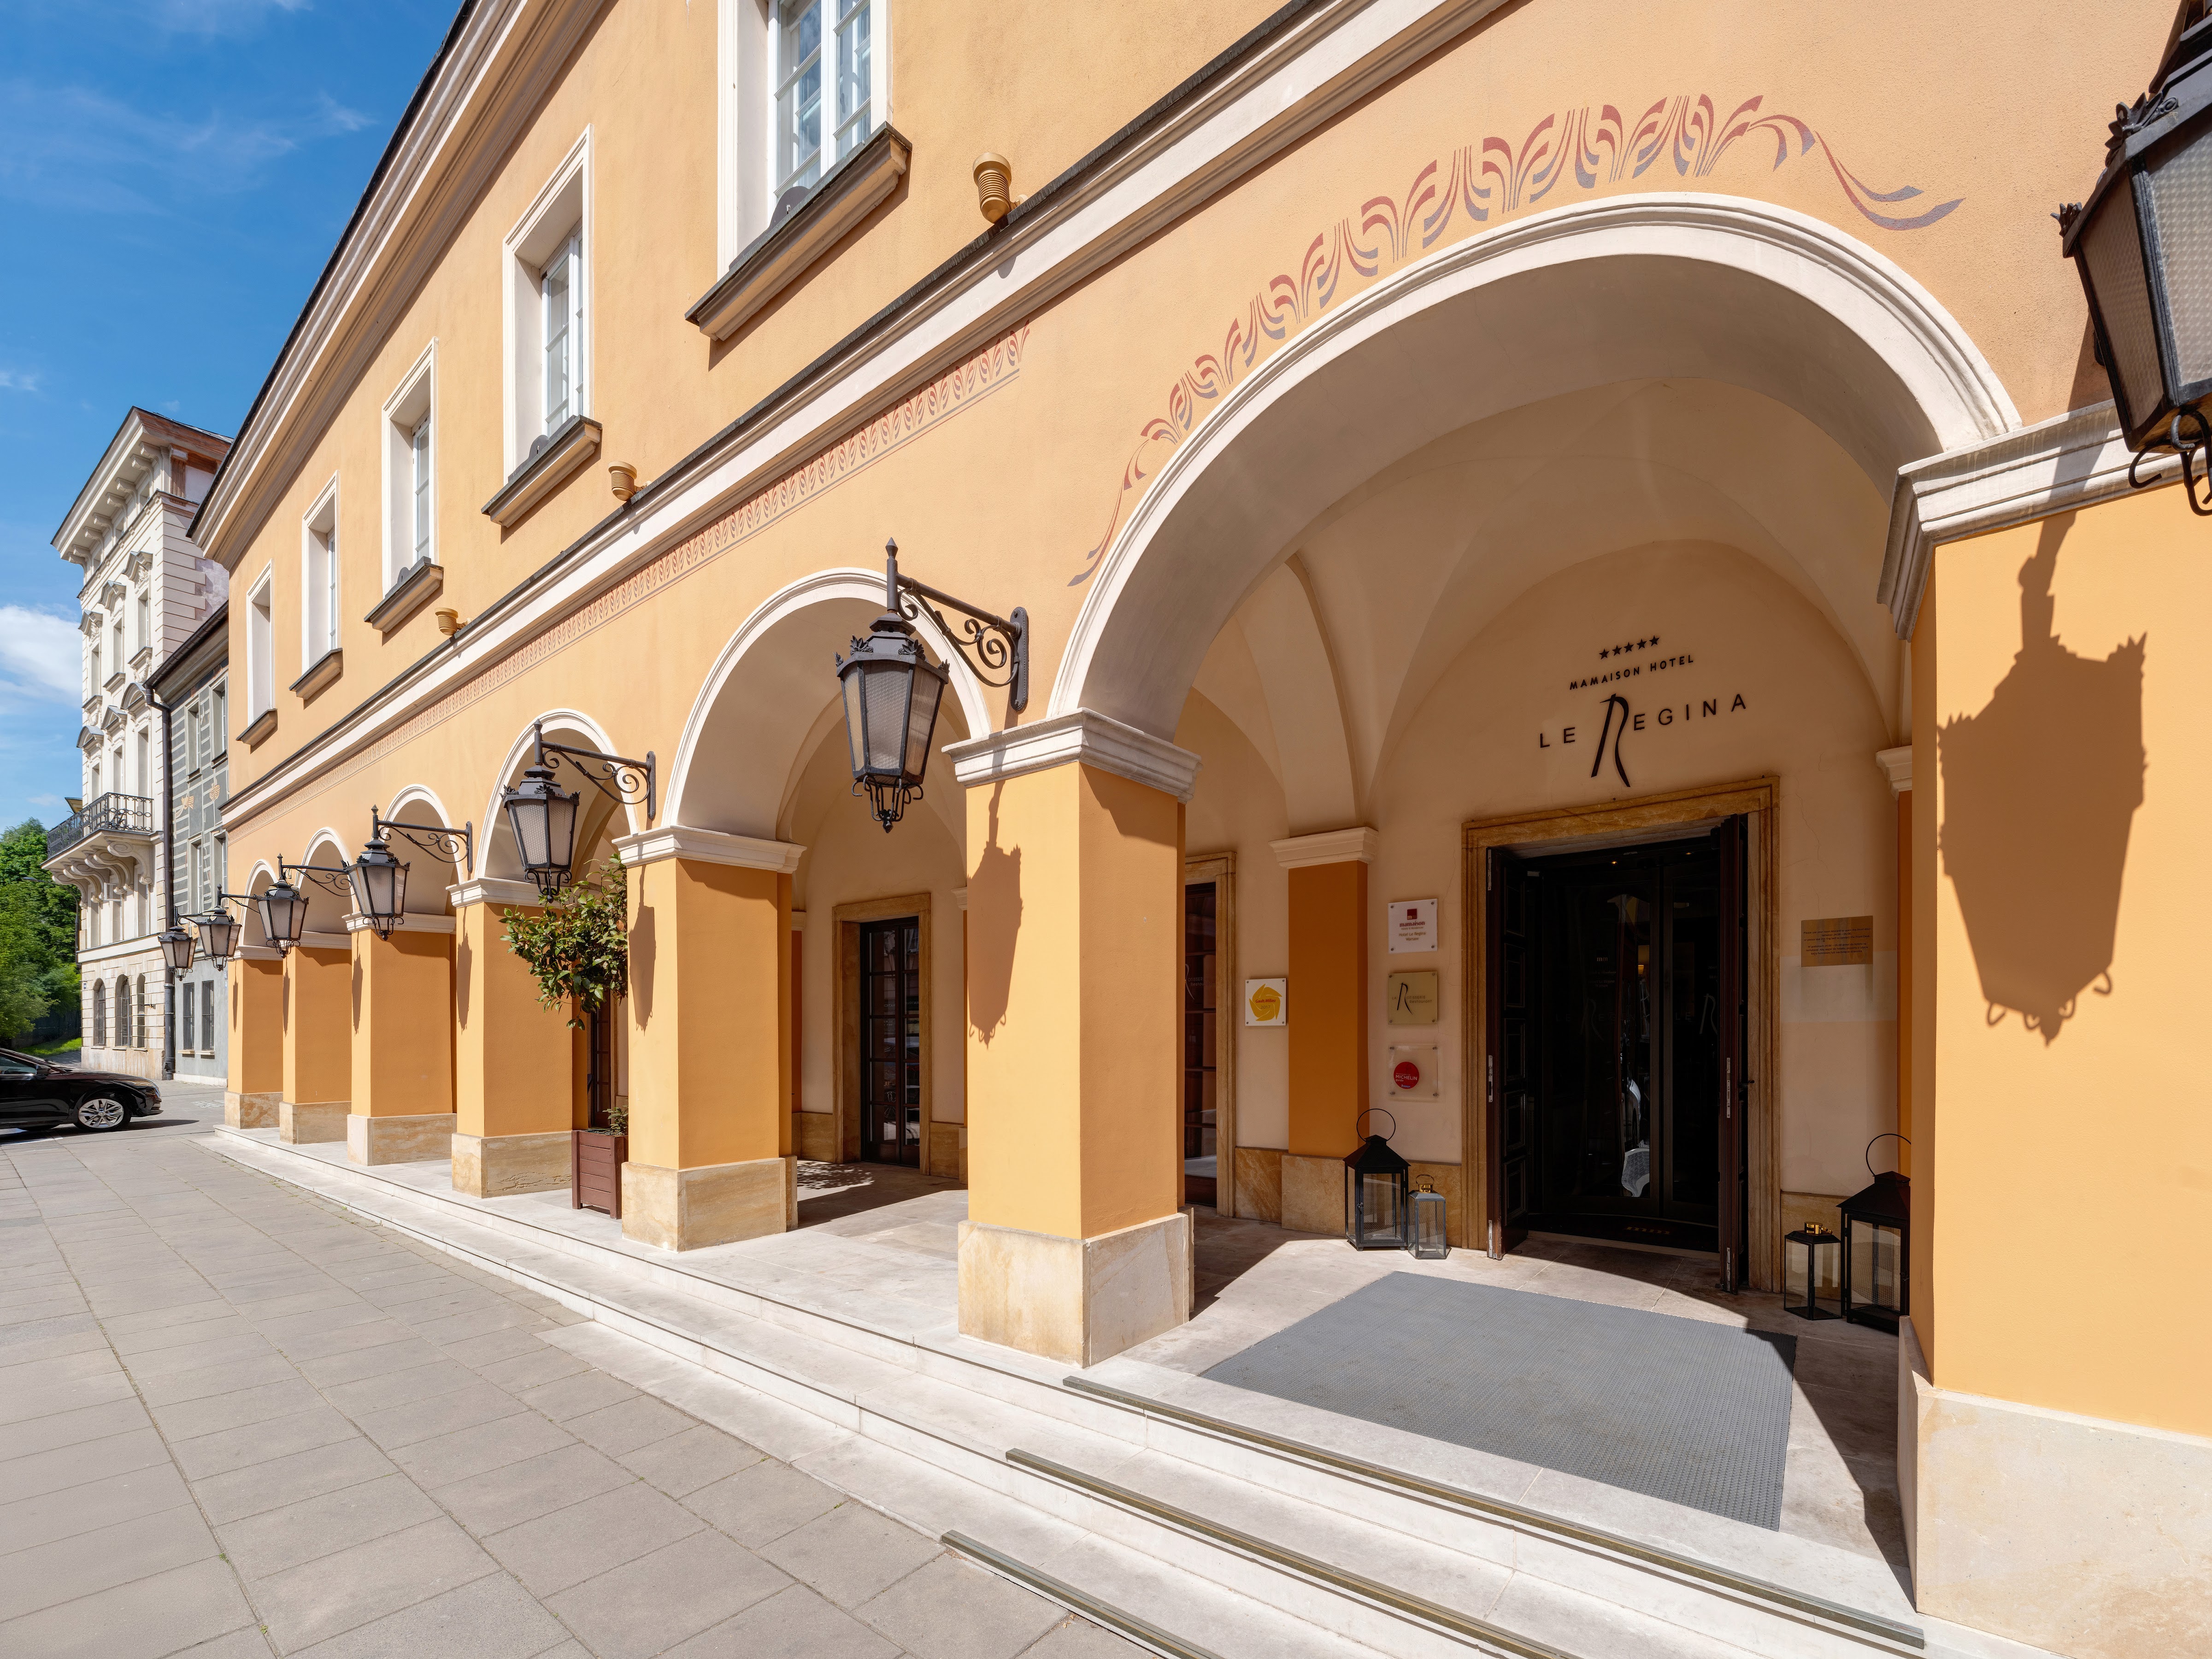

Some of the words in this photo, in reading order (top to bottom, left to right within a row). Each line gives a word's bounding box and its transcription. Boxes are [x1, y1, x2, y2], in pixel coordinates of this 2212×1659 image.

[1569, 666, 1640, 690] MAMAISON
[1650, 654, 1694, 672] HOTEL
[1539, 727, 1576, 748] LE
[1591, 693, 1747, 788] REGINA
[1397, 982, 1426, 1015] ROTISSERIE
